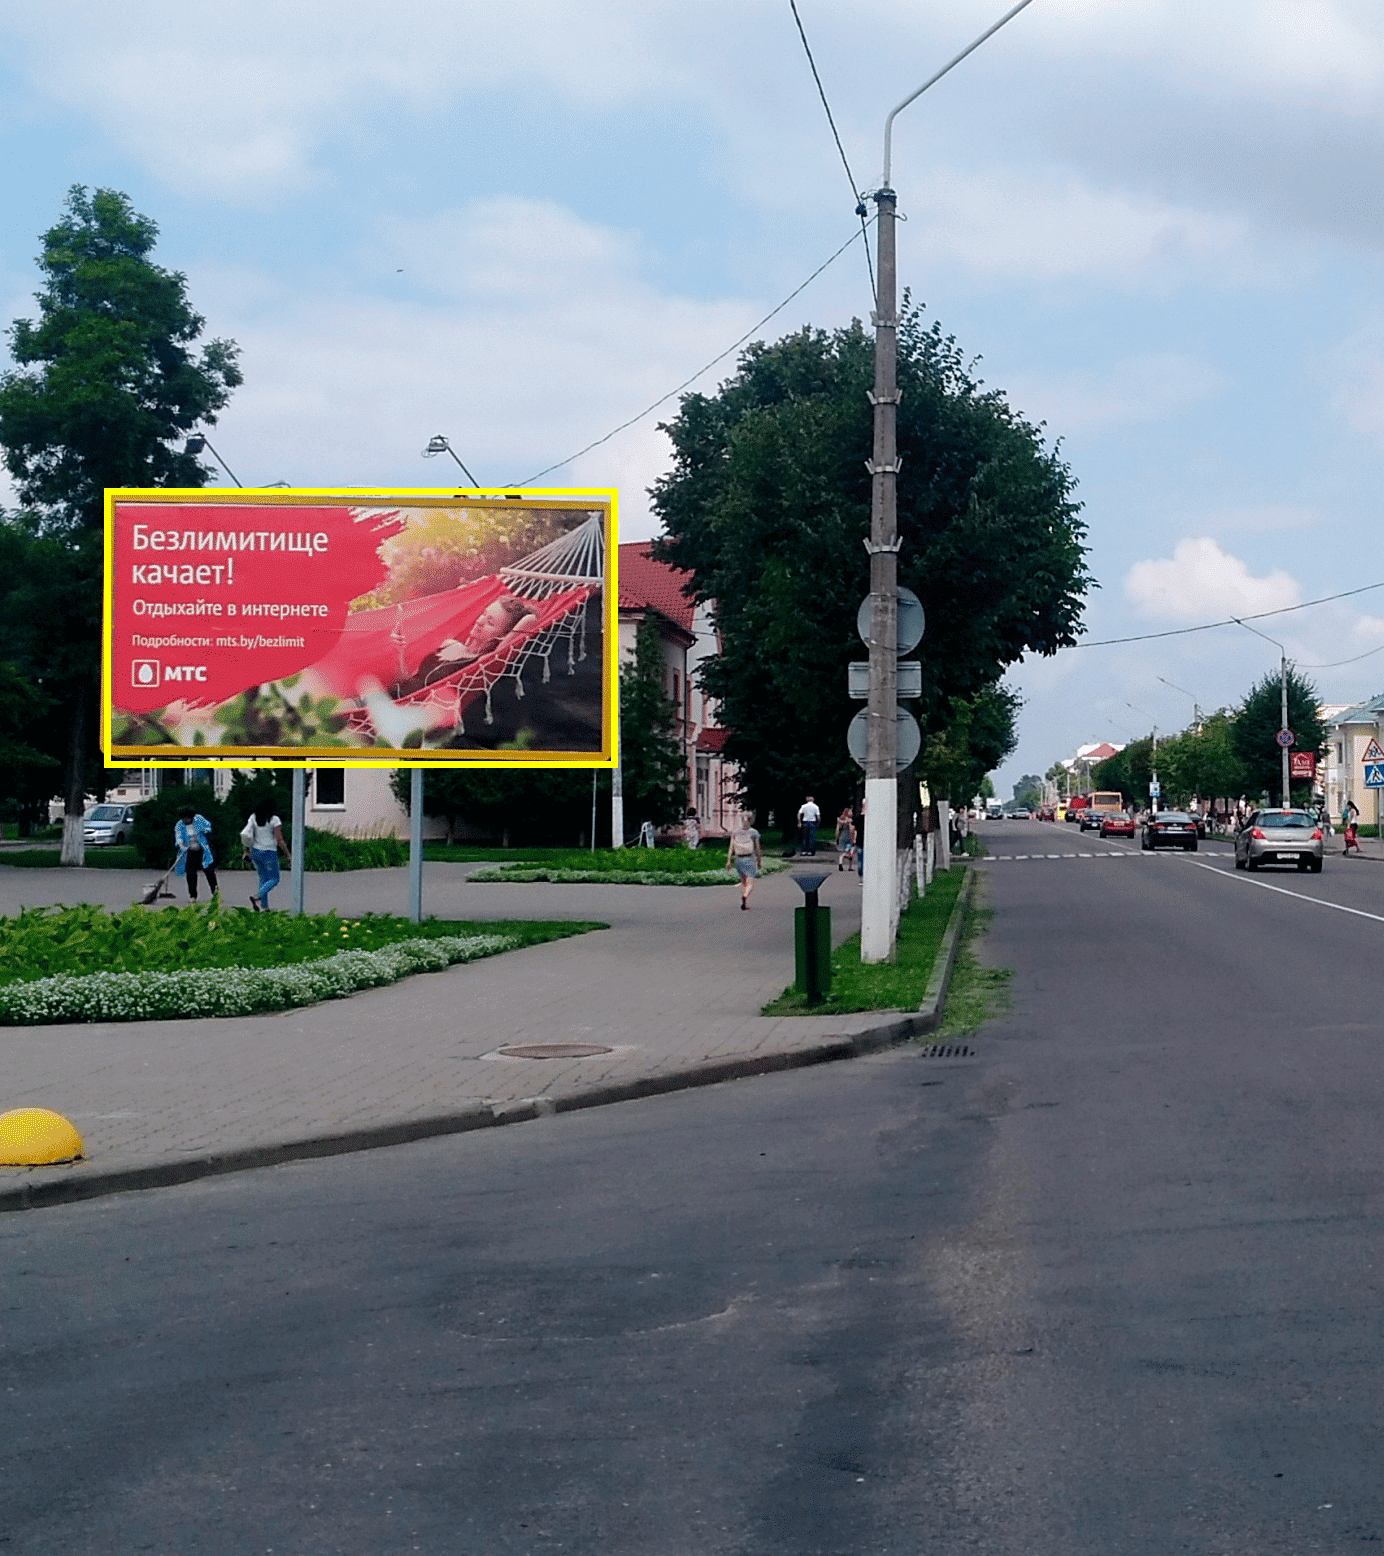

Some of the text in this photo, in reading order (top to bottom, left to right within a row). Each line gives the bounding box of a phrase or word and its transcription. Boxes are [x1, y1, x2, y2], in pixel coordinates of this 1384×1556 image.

[133, 524, 329, 557] Безлимитище
[132, 557, 235, 585] качает!
[132, 598, 329, 620] Отдыхайте в интернете
[132, 634, 305, 650] Подробности: mts.by/bezlimit
